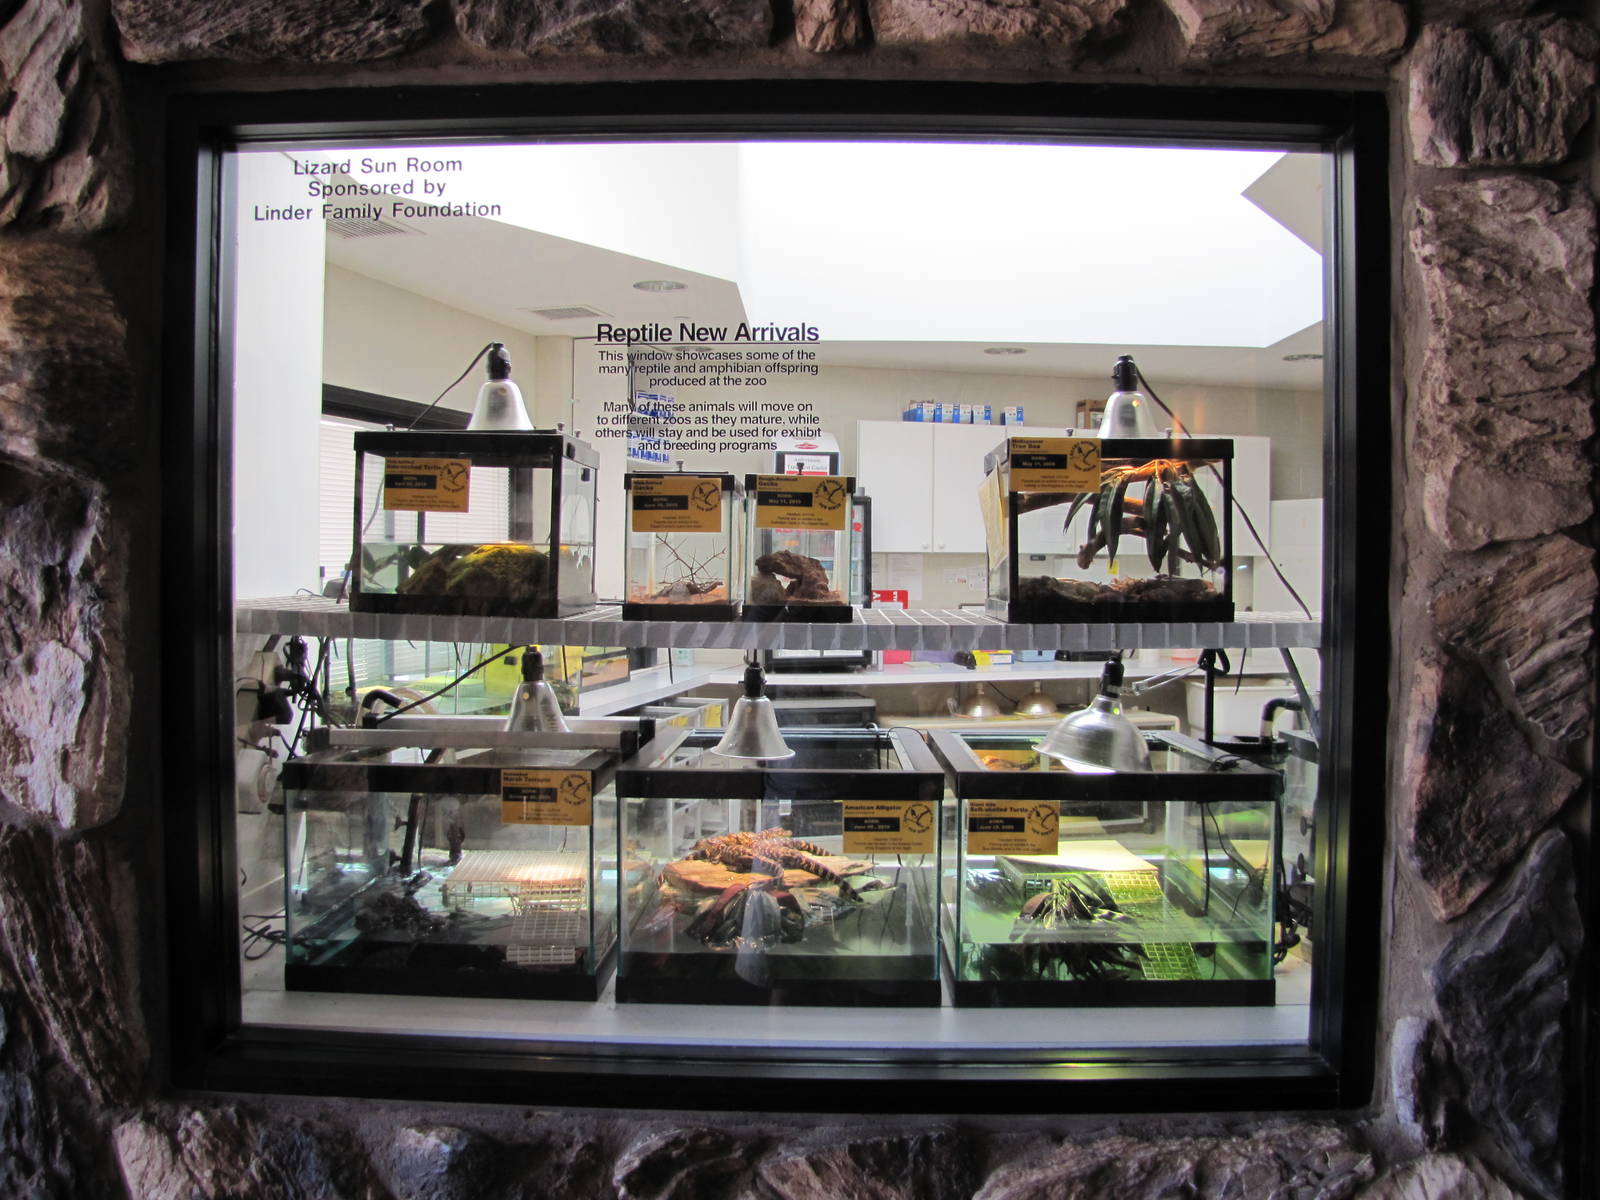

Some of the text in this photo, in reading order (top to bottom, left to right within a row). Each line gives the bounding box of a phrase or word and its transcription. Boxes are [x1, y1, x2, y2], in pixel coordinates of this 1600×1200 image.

[293, 157, 463, 175] Lizard Sun Room
[308, 179, 446, 199] Sponsored by
[254, 202, 502, 221] Linder Family Foundation
[597, 322, 820, 346] Reptile New Arrivals
[599, 349, 816, 361] This window showcases some of the
[598, 362, 819, 376] many reptile and amphibian offspring
[649, 375, 767, 388] produced at the zoo
[603, 401, 813, 414] Many of these animals will move on
[597, 415, 609, 425] to
[611, 414, 659, 425] different
[662, 417, 692, 425] zoos
[694, 416, 709, 425] as
[711, 415, 737, 426] they
[788, 414, 820, 424] while
[595, 427, 822, 440] others will stay and be used for exhibit
[638, 440, 778, 453] and breeding programs
